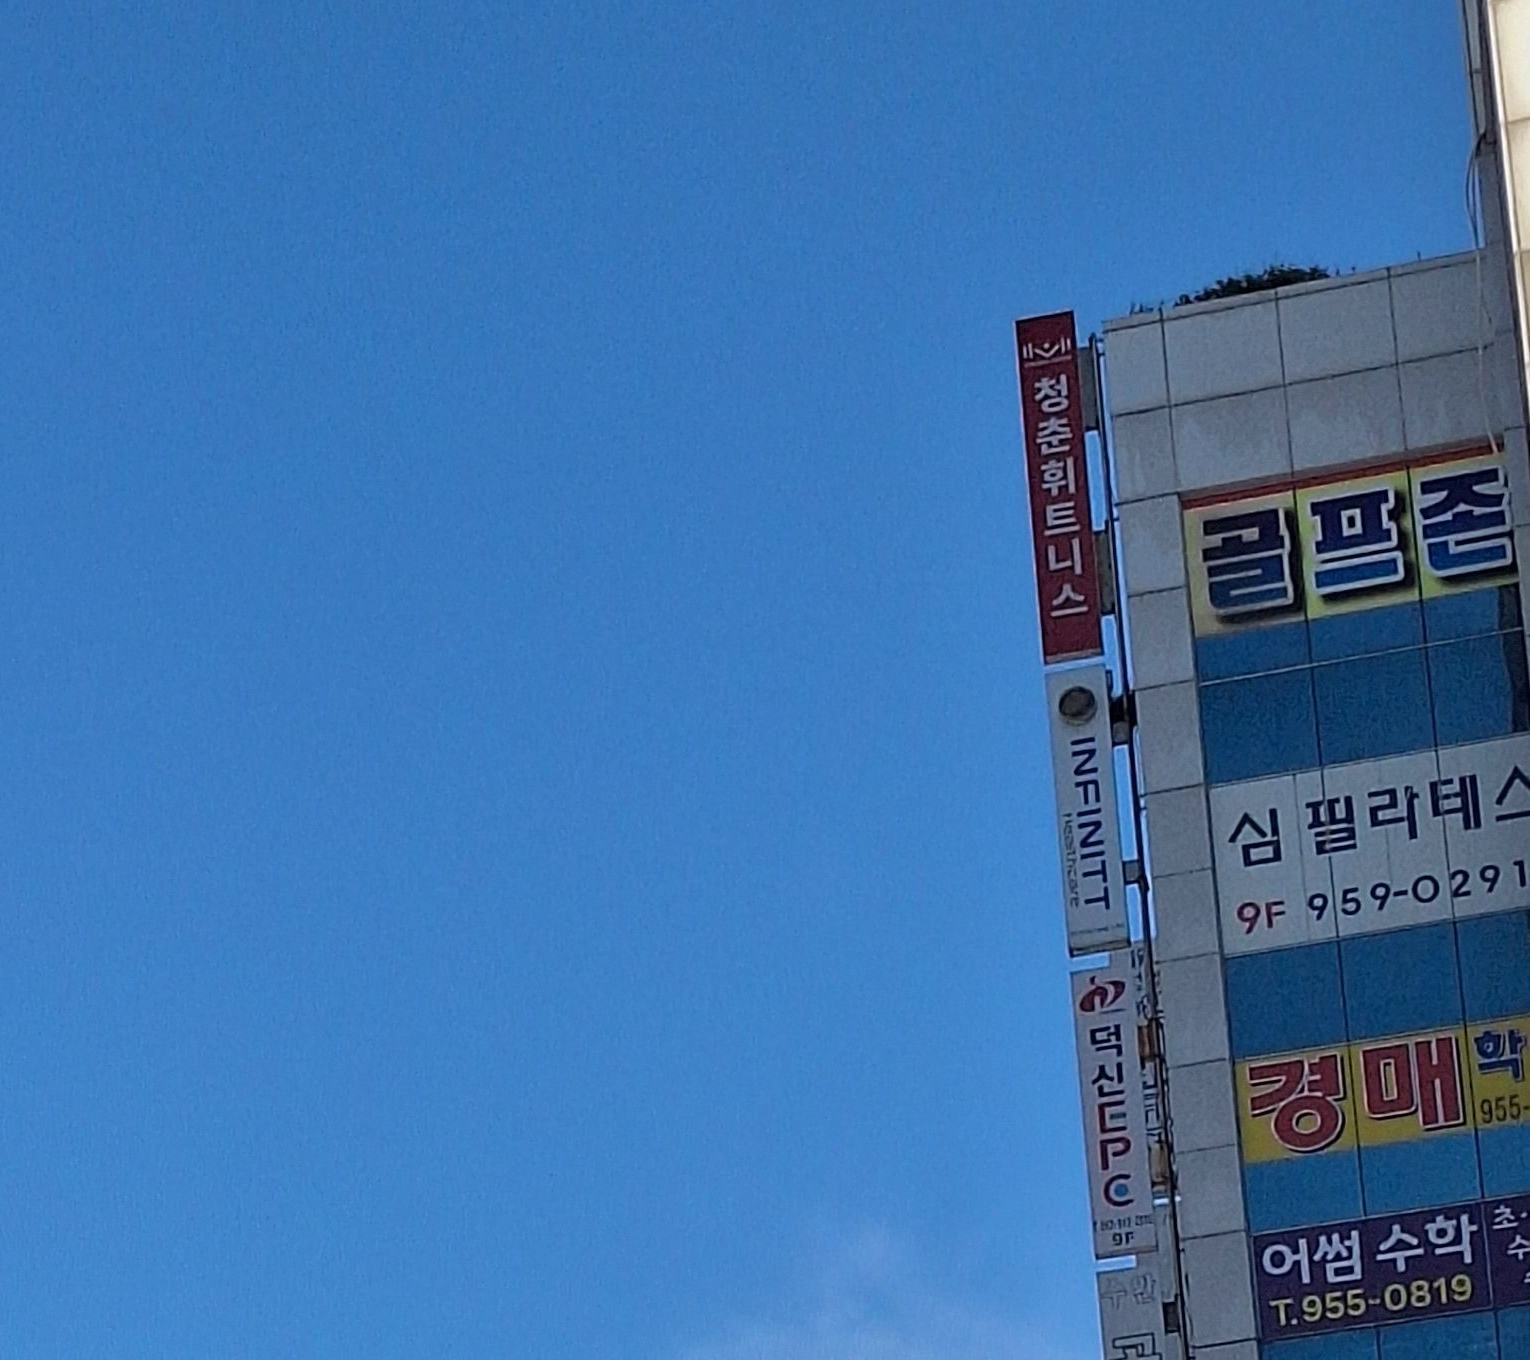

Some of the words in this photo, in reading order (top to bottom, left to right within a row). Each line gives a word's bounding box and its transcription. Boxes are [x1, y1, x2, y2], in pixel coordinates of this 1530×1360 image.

[1033, 373, 1089, 618] 청춘휘트니스
[1200, 466, 1513, 613] 골프존
[1071, 737, 1111, 911] INFINITT
[1236, 900, 1286, 935] 9F
[1307, 859, 1528, 921] 959-0291
[1246, 1032, 1466, 1154] 경매
[1262, 1229, 1364, 1286] 어썸
[1375, 1212, 1479, 1275] 수학
[1269, 1273, 1474, 1328] T.955-0819
